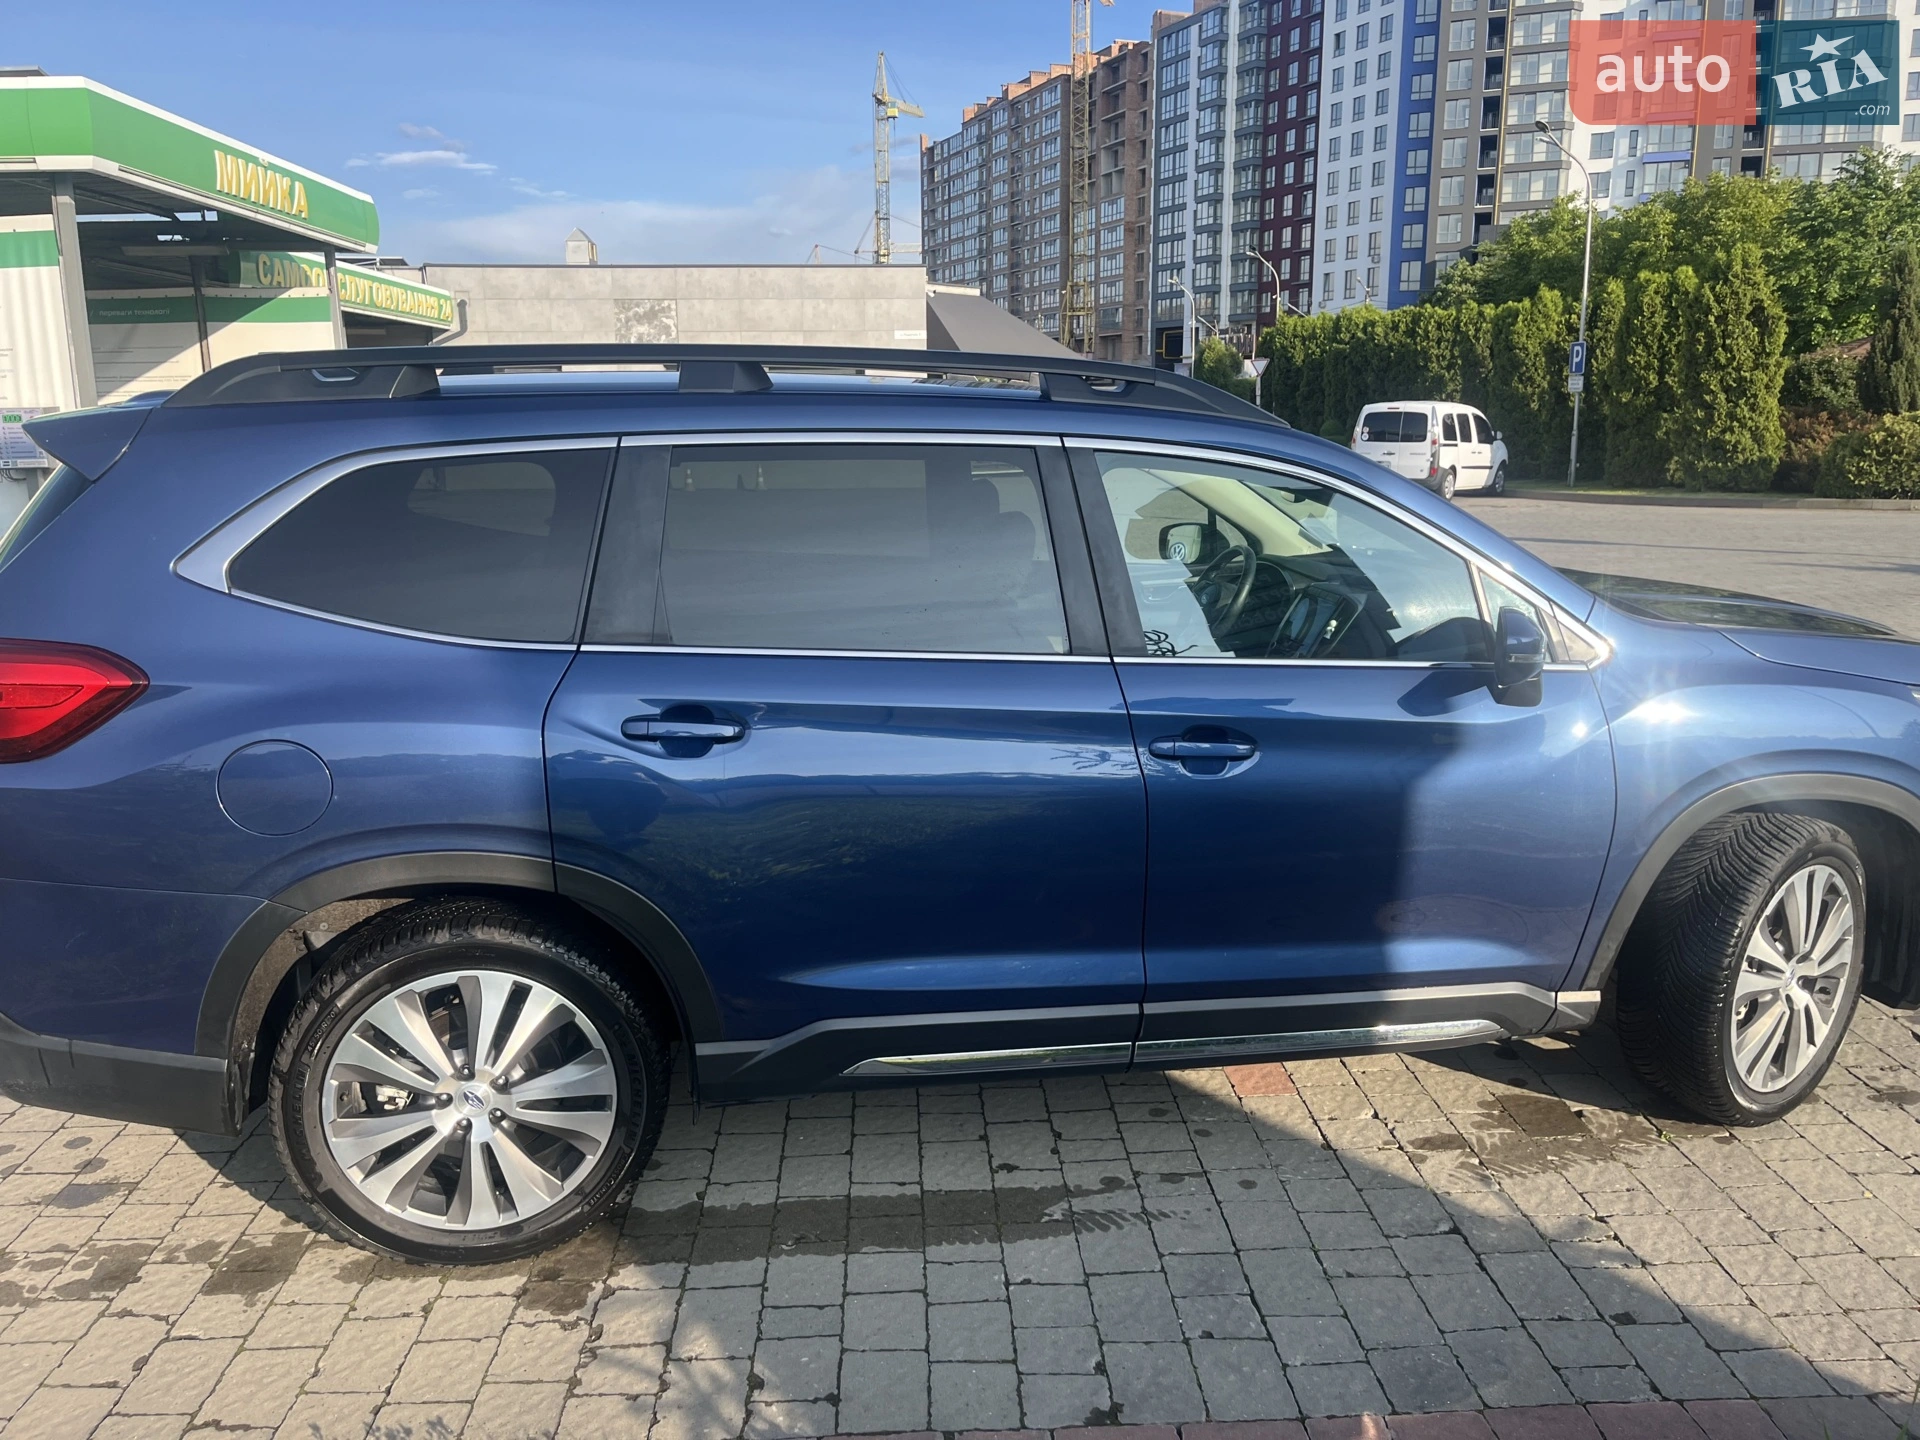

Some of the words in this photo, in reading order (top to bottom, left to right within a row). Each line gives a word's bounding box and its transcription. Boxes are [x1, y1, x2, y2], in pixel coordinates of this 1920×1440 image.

[214, 150, 308, 220] МИЙКА
[258, 253, 440, 319] САМООСЛУГОВУВАННЯ
[440, 298, 453, 320] 24
[1572, 345, 1582, 372] P
